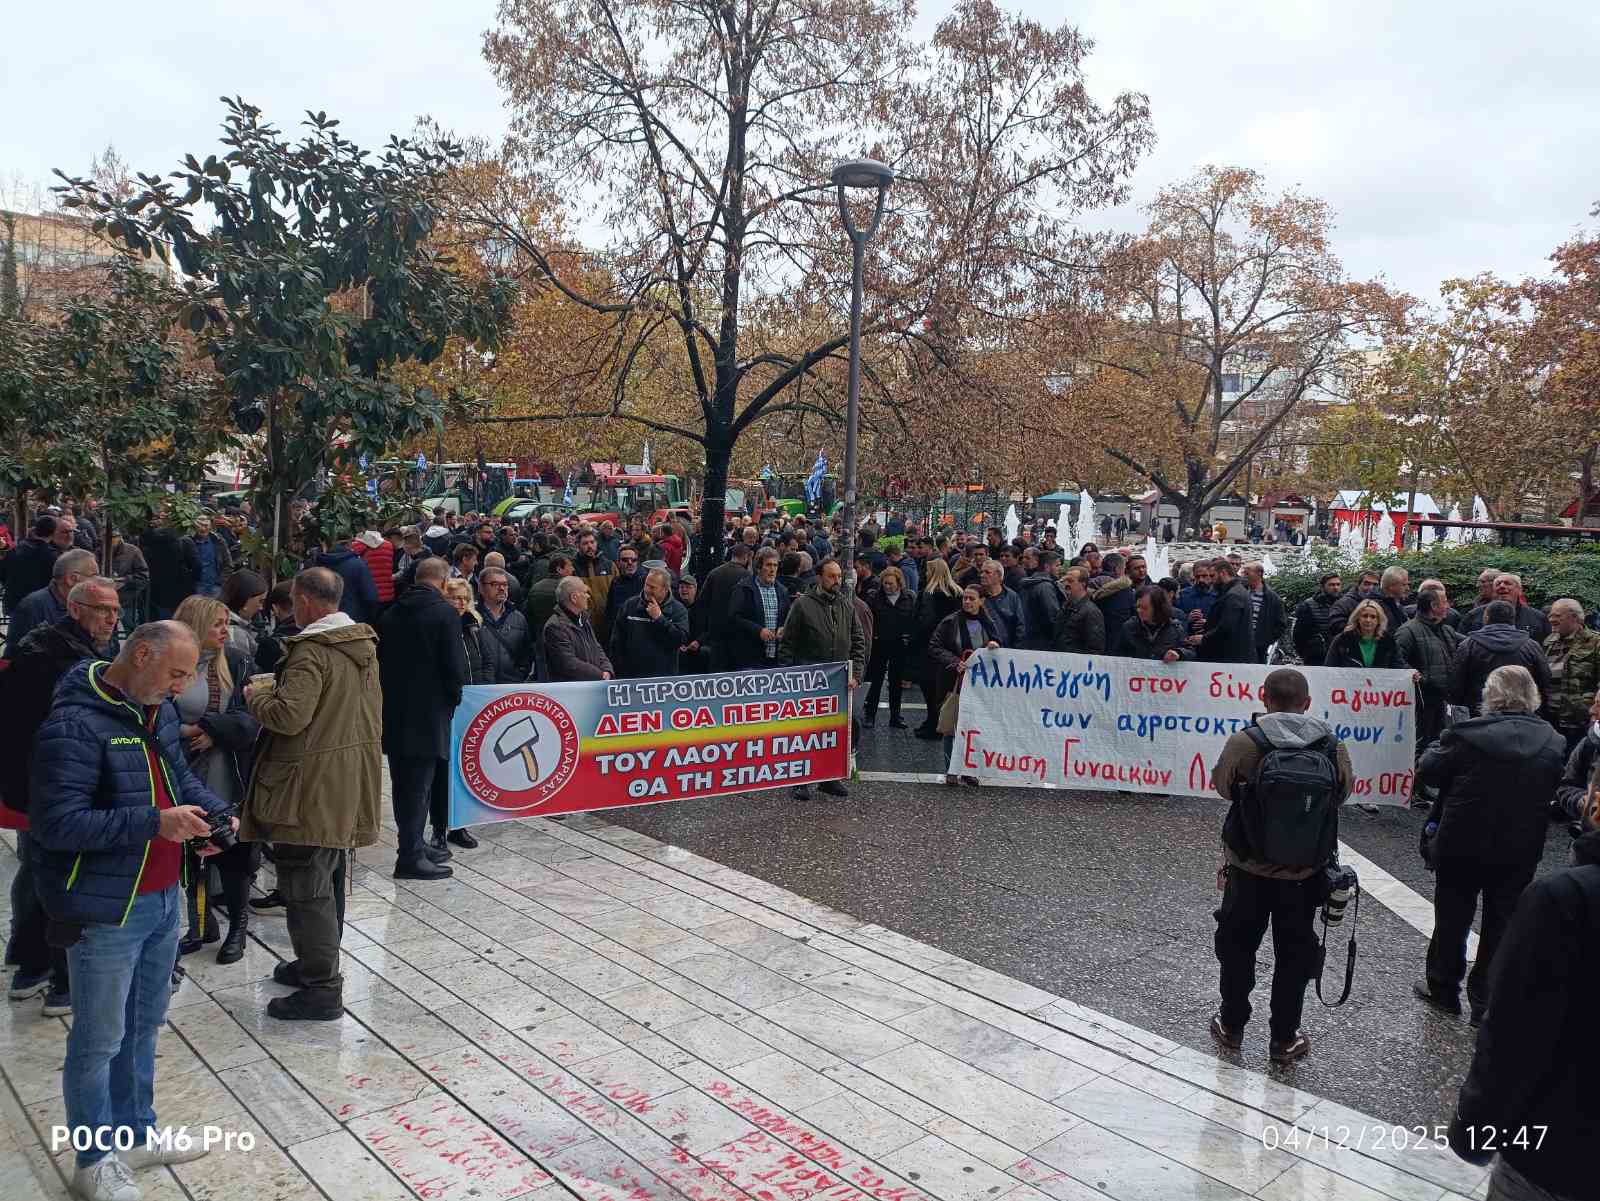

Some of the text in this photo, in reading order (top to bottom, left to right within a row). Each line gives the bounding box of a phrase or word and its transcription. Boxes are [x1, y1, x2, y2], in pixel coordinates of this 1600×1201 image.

[607, 670, 829, 707] Η ΤΡΟΜΟΚΡΑΤΙΑ
[969, 657, 1412, 712] Αλληλεγγύη στον δίκ αγώνα
[527, 696, 570, 730] ΚΕΝΤΡΟ
[595, 695, 839, 736] ΔΕΝ ΘΑ ΠΕΡΑΣΕΙ
[1041, 711, 1093, 729] των
[541, 747, 576, 796] ΛΑΡΙΣΑΣ
[596, 730, 838, 775] ΤΟΥ ΛΑΟΥ Η ΠΑΛΗ
[961, 729, 1047, 781] Ένωση
[1063, 737, 1173, 787] Γυναικών
[627, 760, 811, 798] ΘΑ ΤΗ ΣΠΑΣΕΙ
